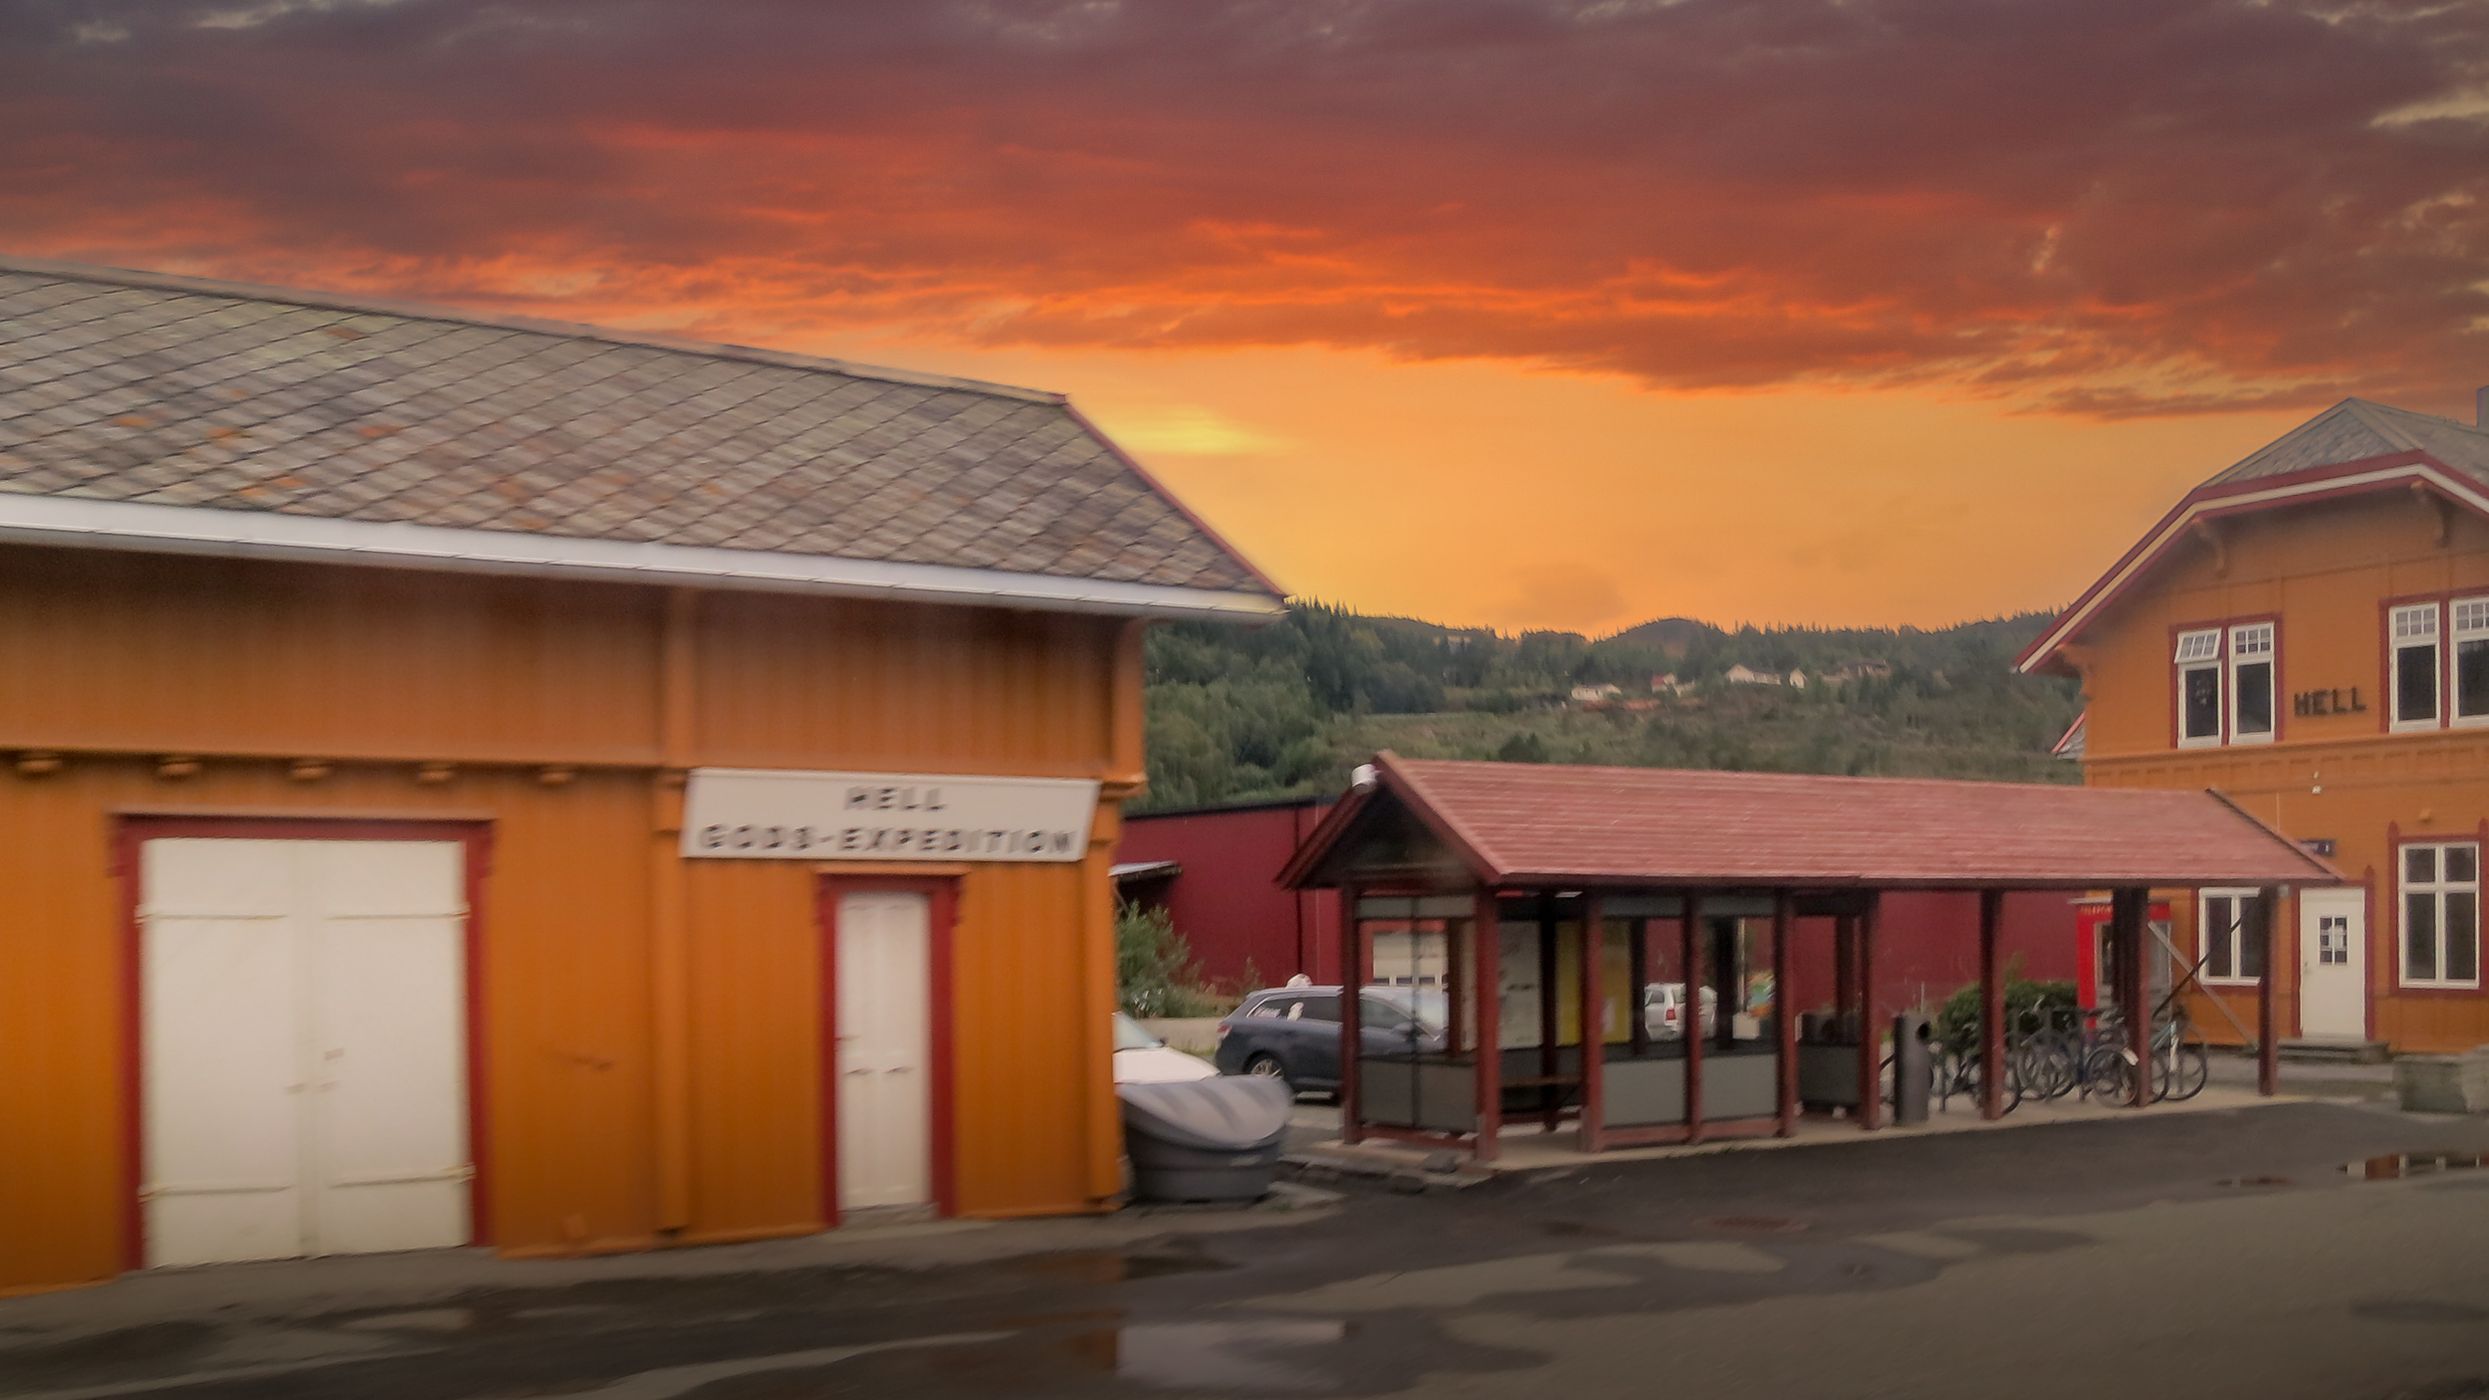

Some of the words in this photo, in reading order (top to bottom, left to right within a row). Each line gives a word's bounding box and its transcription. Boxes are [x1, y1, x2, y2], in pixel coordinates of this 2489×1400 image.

[2294, 687, 2368, 716] HELL
[845, 787, 946, 811] HELL
[699, 824, 1075, 853] GODS-EXPEDITION
